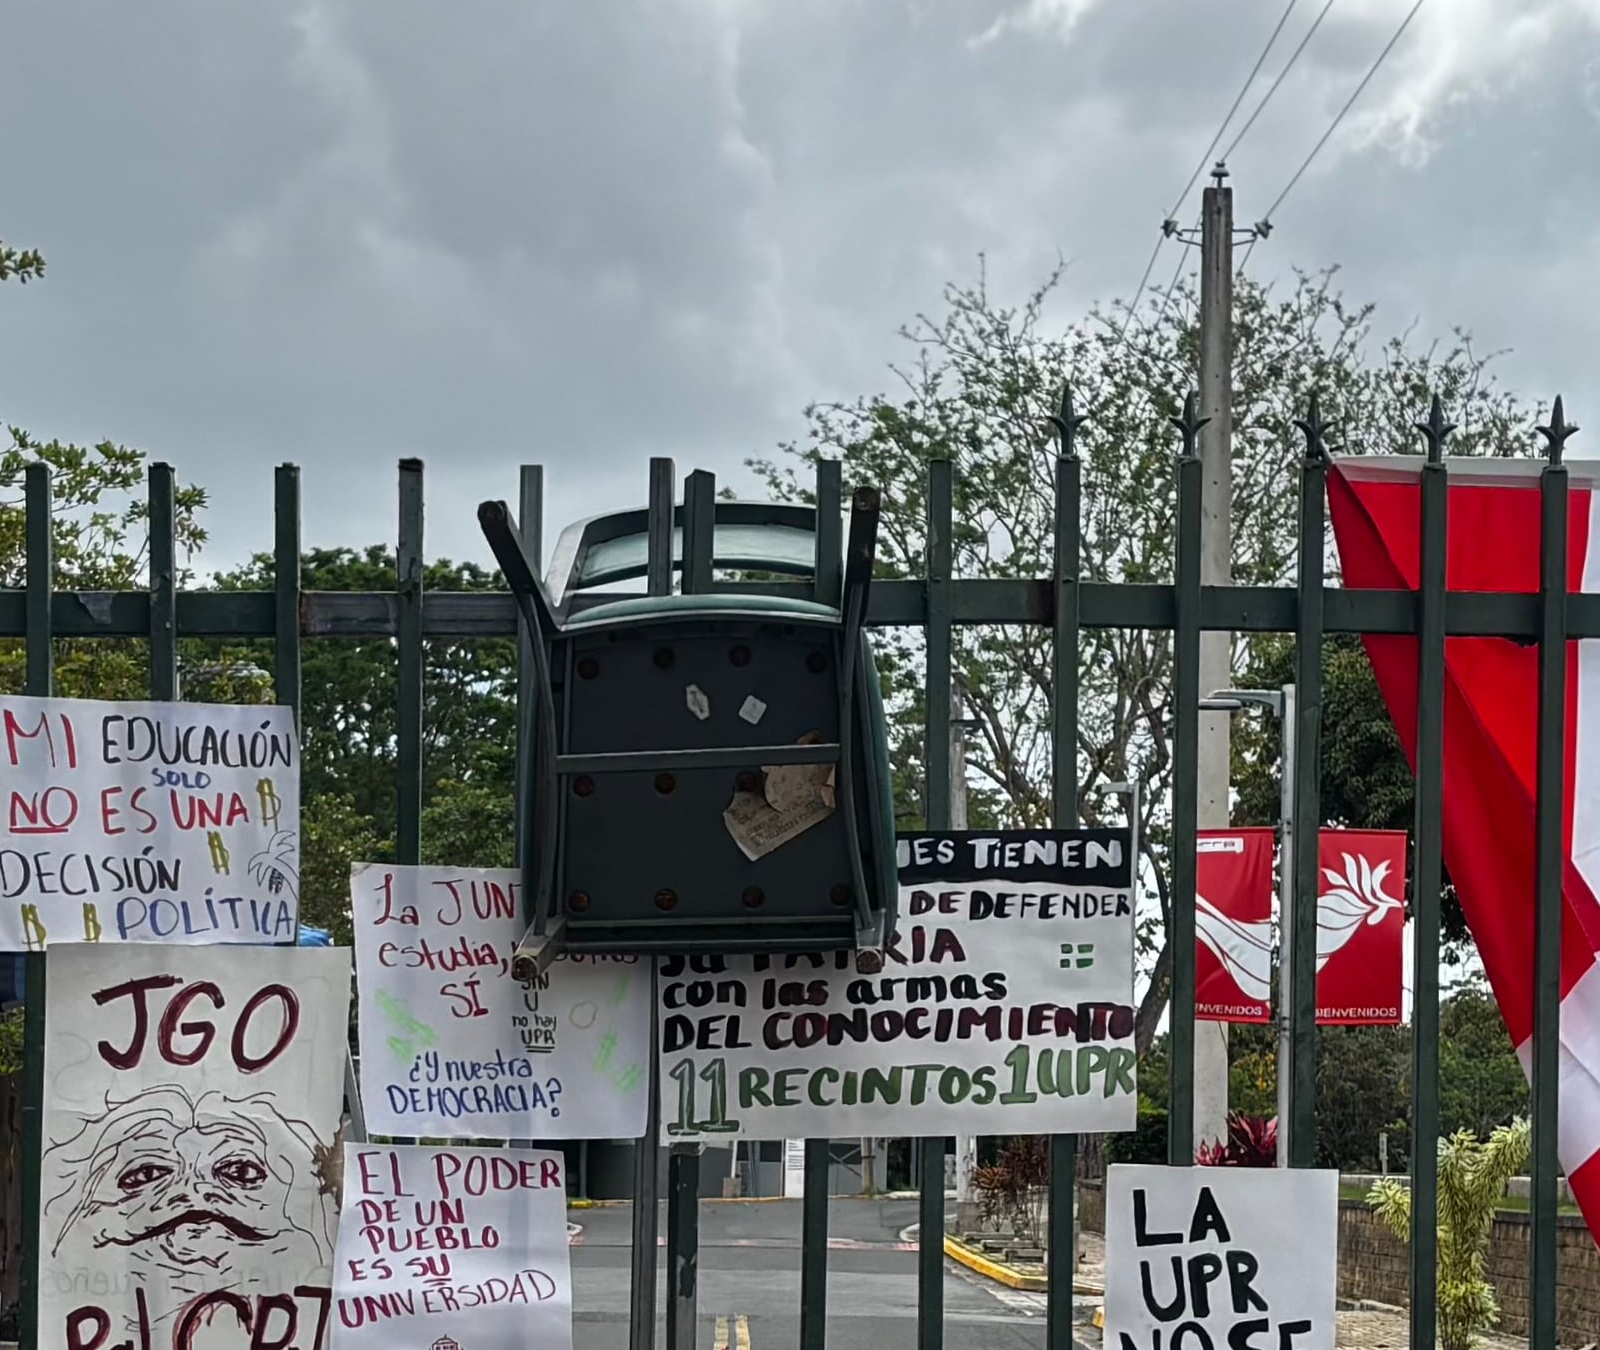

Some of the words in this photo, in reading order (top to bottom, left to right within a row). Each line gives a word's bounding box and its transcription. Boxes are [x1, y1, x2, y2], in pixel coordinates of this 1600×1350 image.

[3, 709, 77, 768] MI
[103, 715, 291, 768] EDUCACIÓN
[152, 768, 211, 789] SOLO
[9, 787, 78, 830] NO
[102, 786, 157, 835] ES
[171, 789, 249, 830] UNA
[116, 887, 294, 940] POLÍTICA
[373, 873, 419, 926] La
[432, 878, 522, 926] JUN
[909, 890, 965, 916] DE
[968, 891, 1131, 920] DEFENDER
[379, 936, 509, 978] estudia,
[440, 971, 489, 1018] SÍ
[524, 992, 539, 1012] U
[663, 979, 747, 1010] con
[762, 978, 829, 1008] las
[846, 971, 1008, 1004] armas
[92, 974, 300, 1074] JGO
[512, 1014, 531, 1028] no
[534, 1013, 557, 1031] hay
[521, 1030, 555, 1045] UPR
[662, 1015, 753, 1053] DEL
[762, 1002, 1135, 1050] CONOCIMIENTO
[446, 1049, 533, 1079] nuestra
[386, 1077, 562, 1118] DEMOCRACIA?
[738, 1064, 997, 1109] RECINTOS
[357, 1151, 415, 1196] EL
[431, 1152, 561, 1199] PODER
[356, 1199, 401, 1225] DE
[415, 1198, 464, 1225] UN
[1132, 1186, 1231, 1247] LA
[359, 1225, 499, 1254] PUEBLO
[348, 1258, 393, 1281] ES
[406, 1253, 451, 1278] SU
[1140, 1250, 1269, 1322] UPR
[338, 1269, 556, 1328] UNIVERSIDAD
